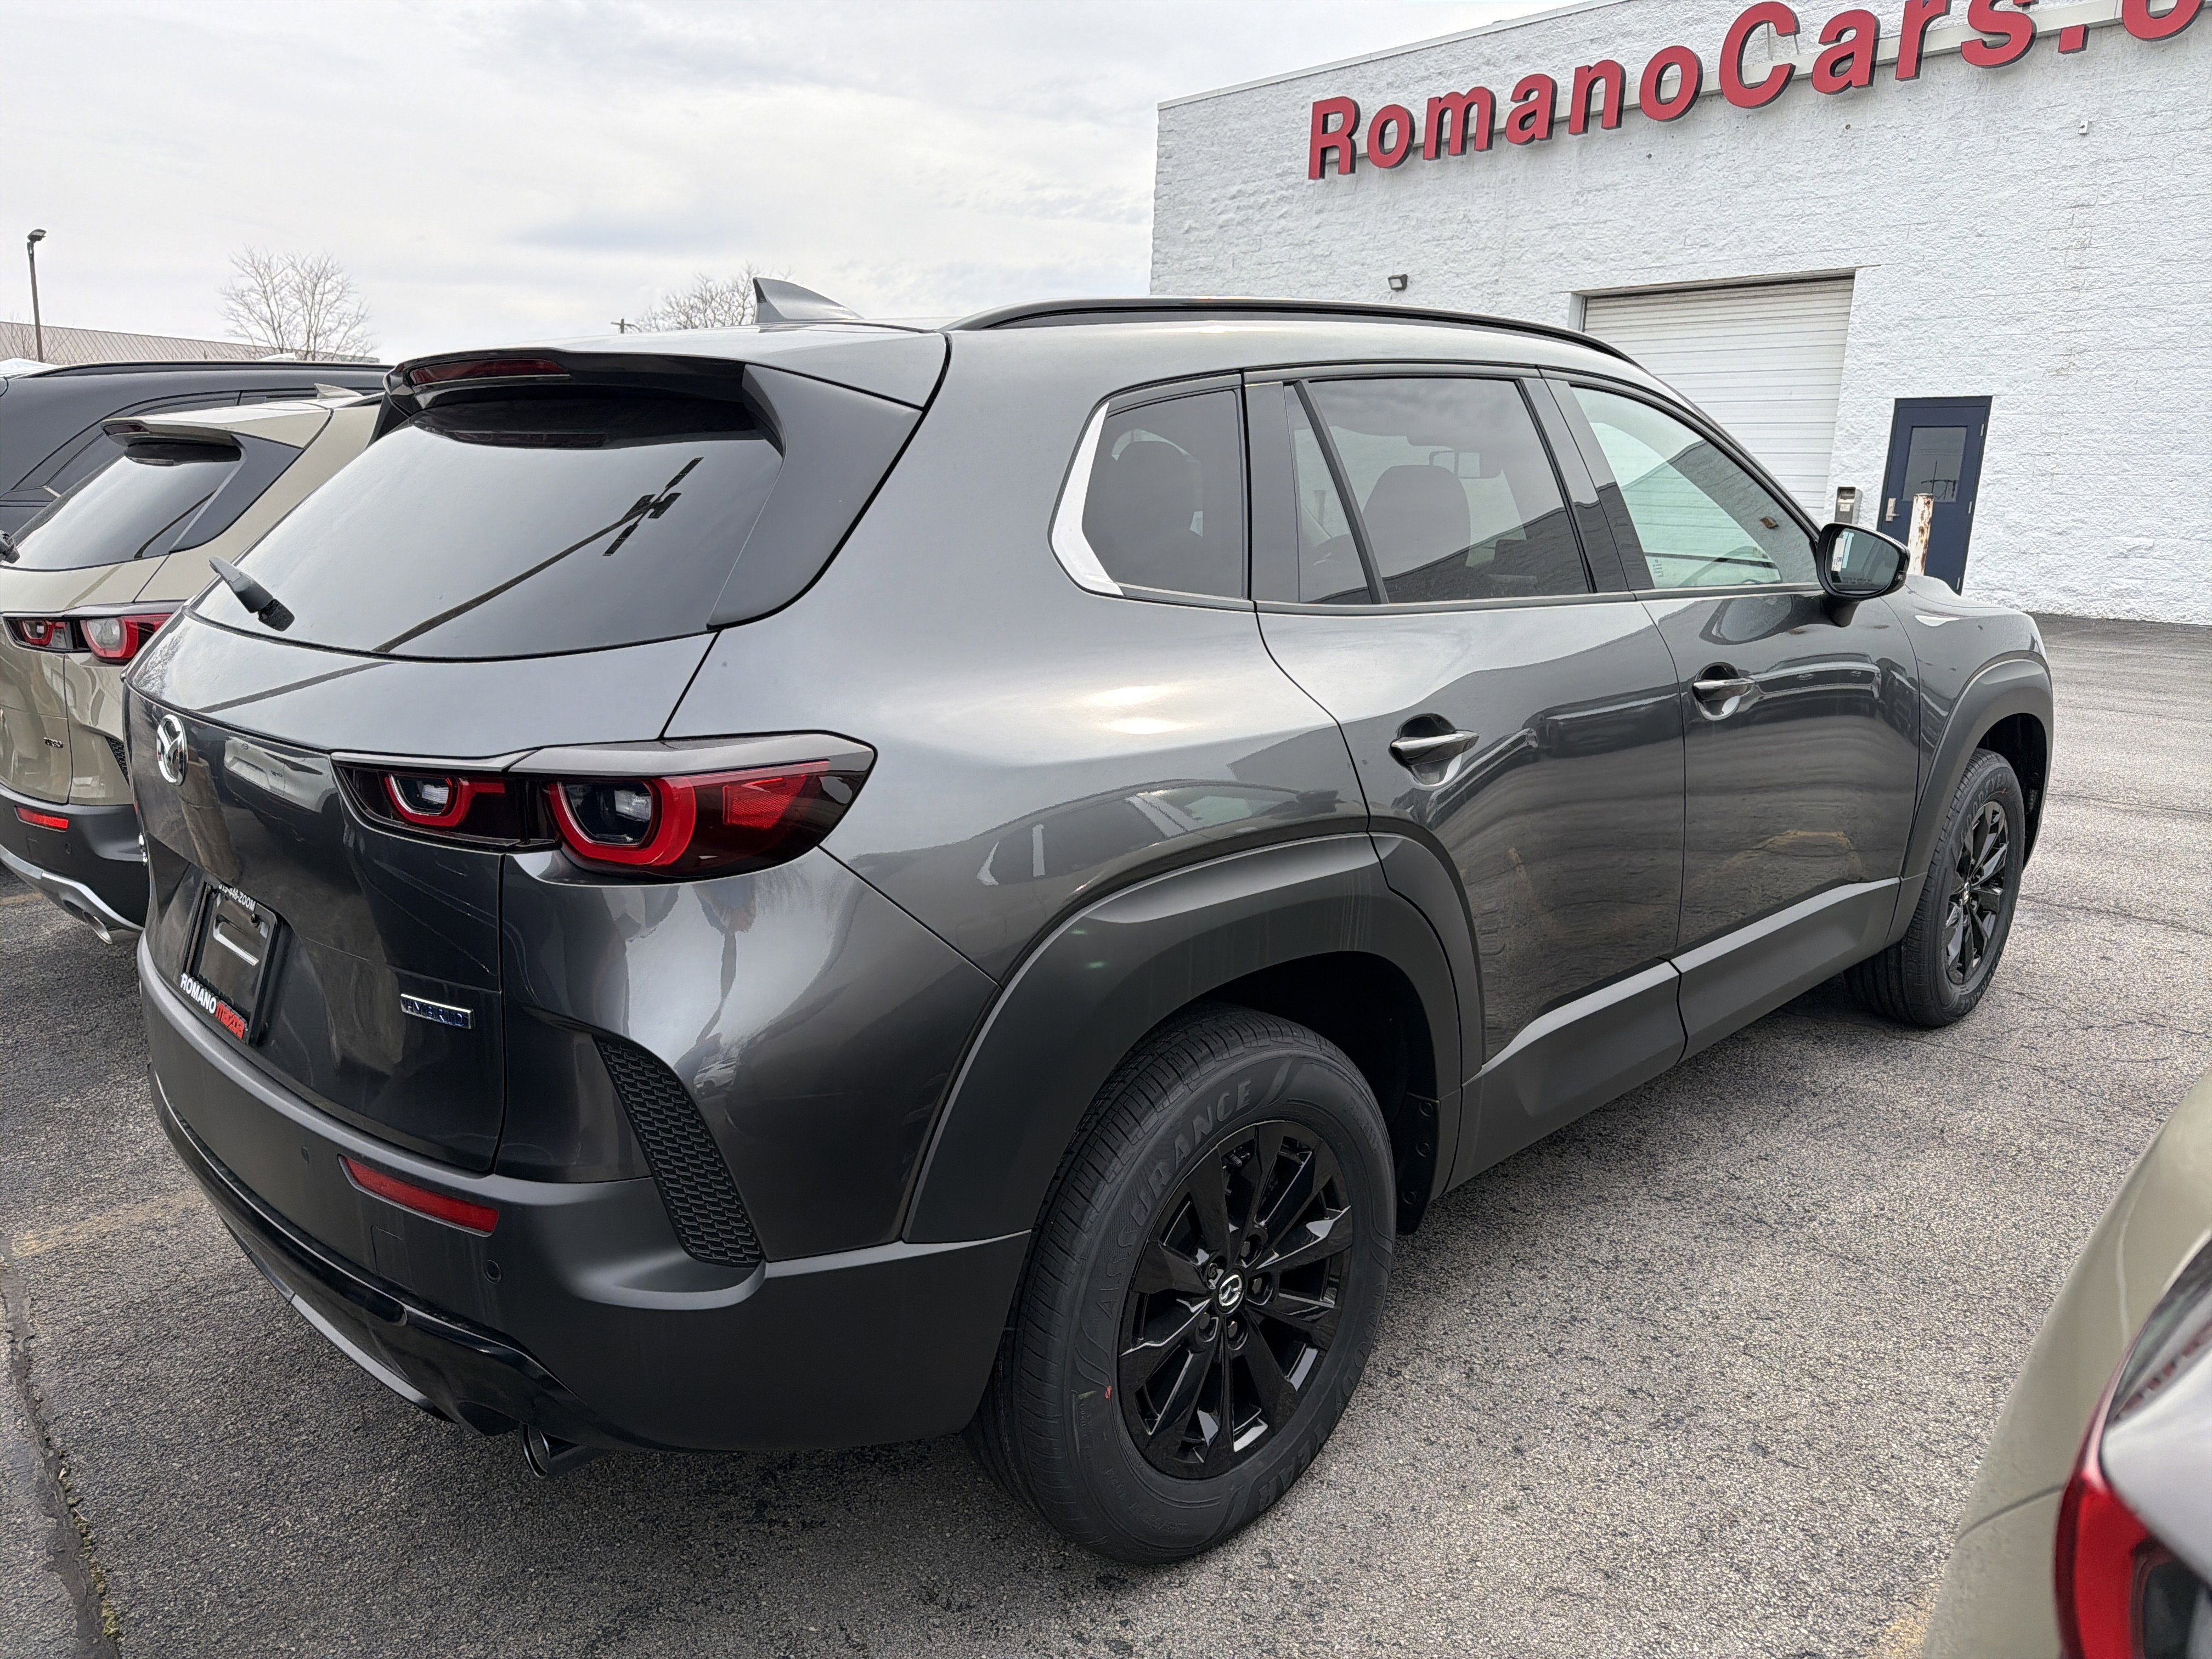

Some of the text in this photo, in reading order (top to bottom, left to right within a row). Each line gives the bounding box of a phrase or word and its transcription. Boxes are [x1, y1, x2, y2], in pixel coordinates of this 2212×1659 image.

[180, 972, 217, 1014] ROMANO
[404, 997, 465, 1026] HYBRID
[1097, 1079, 1251, 1319] ASSURANCE
